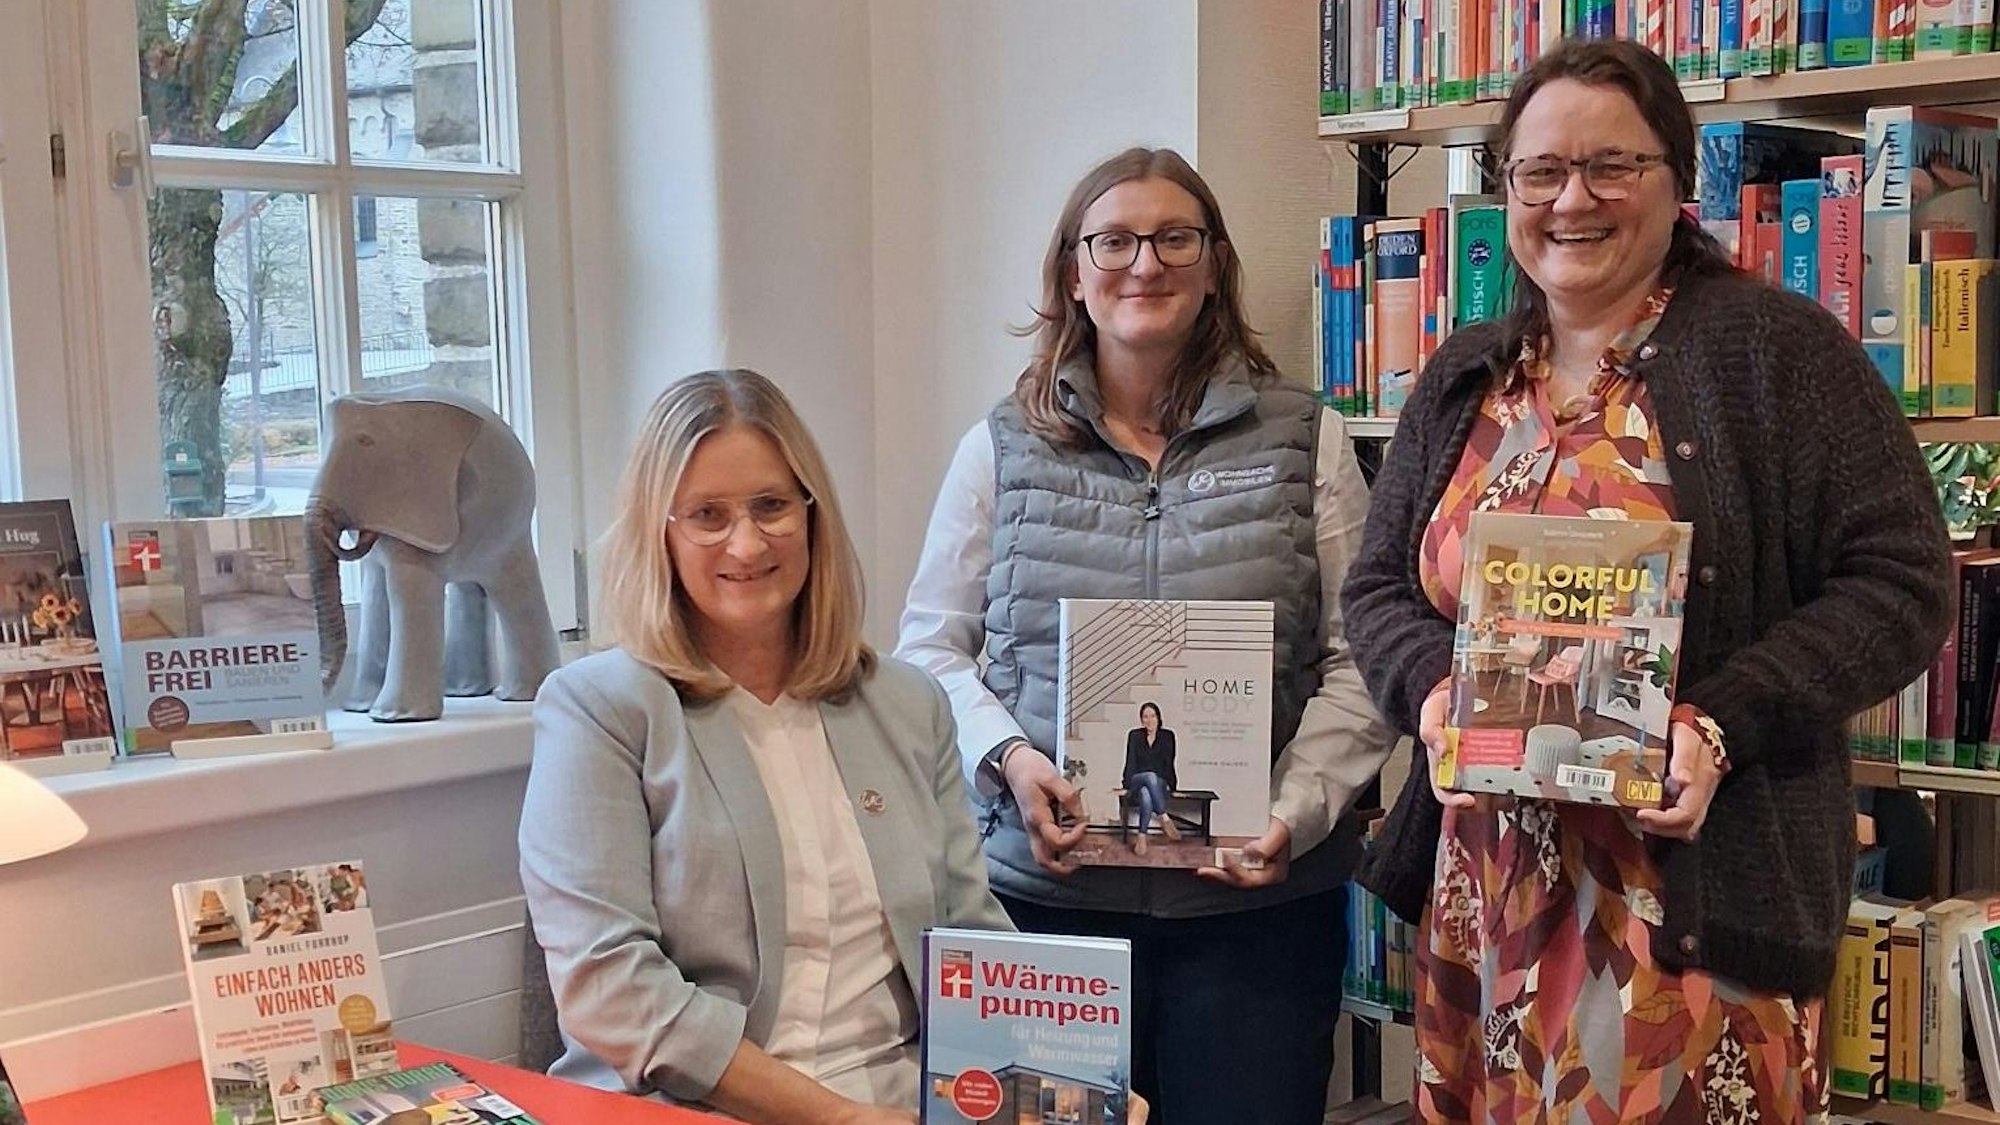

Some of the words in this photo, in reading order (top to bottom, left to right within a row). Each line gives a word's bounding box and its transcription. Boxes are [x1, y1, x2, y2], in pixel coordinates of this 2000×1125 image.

[1323, 38, 1333, 91] KATAPULT
[1377, 244, 1417, 256] OXFORD
[1378, 233, 1416, 245] DUDEN
[1957, 267, 1970, 332] Italienisch
[5, 528, 41, 545] Hug
[1484, 560, 1656, 594] COLORFUL
[1519, 591, 1615, 619] HOME
[146, 643, 309, 671] BARRIERE-
[148, 670, 212, 693] FREI
[1184, 679, 1254, 695] HOME
[1183, 696, 1253, 713] BODY
[266, 938, 301, 956] DANIEL
[215, 965, 292, 998] EINFACH
[298, 953, 366, 989] ANDERS
[981, 961, 1120, 996] Wärme-
[254, 984, 337, 1018] WOHNEN
[981, 995, 1120, 1026] pumpen
[1092, 1033, 1119, 1048] und
